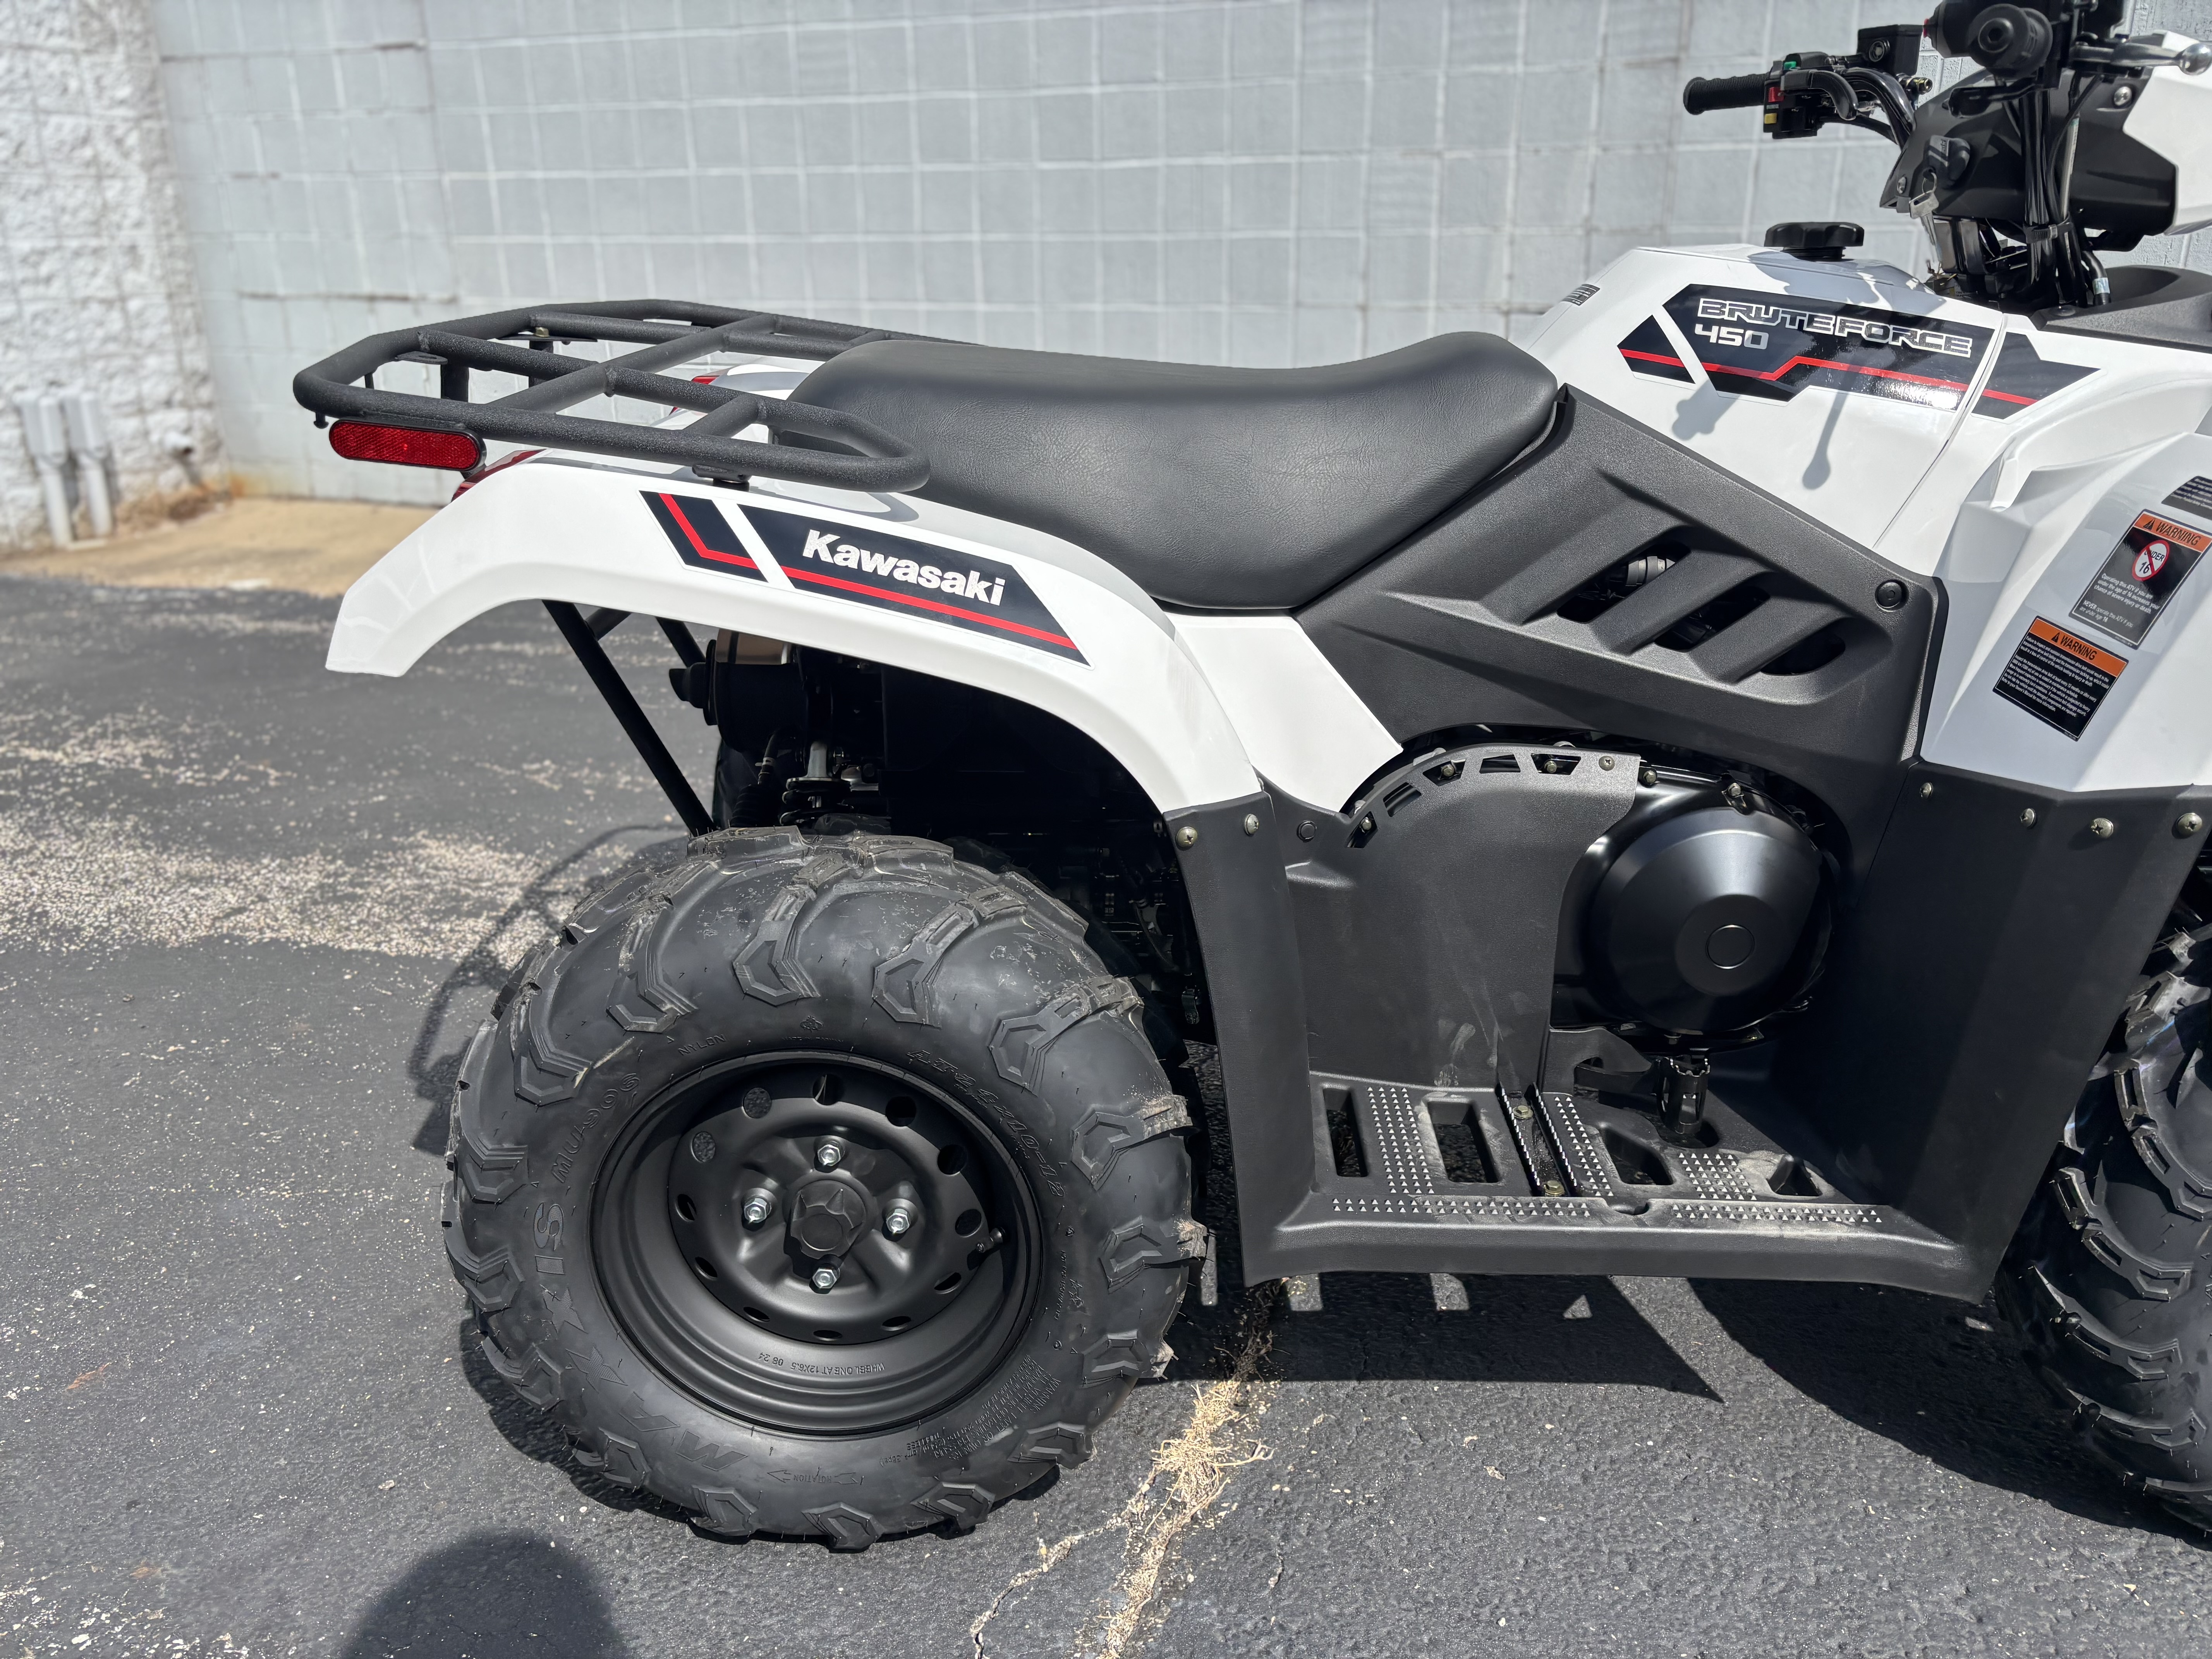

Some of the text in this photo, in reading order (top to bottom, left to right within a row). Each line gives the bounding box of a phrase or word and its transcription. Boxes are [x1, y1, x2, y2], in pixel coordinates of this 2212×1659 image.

[1694, 324, 1769, 350] 450
[1697, 298, 1972, 358] BRUTE FORCE
[2156, 522, 2201, 545] WARNING
[802, 529, 1005, 606] Kawasaki
[2139, 562, 2150, 574] 16
[2083, 600, 2097, 610] NEVER
[2061, 635, 2097, 660] WARNING
[677, 1034, 726, 1056] NYLON
[532, 1199, 750, 1473] MAXXIS
[758, 1352, 771, 1362] 24
[773, 1357, 784, 1366] 08
[855, 1362, 885, 1374] WHEEL
[793, 1474, 832, 1483] ROTATION
